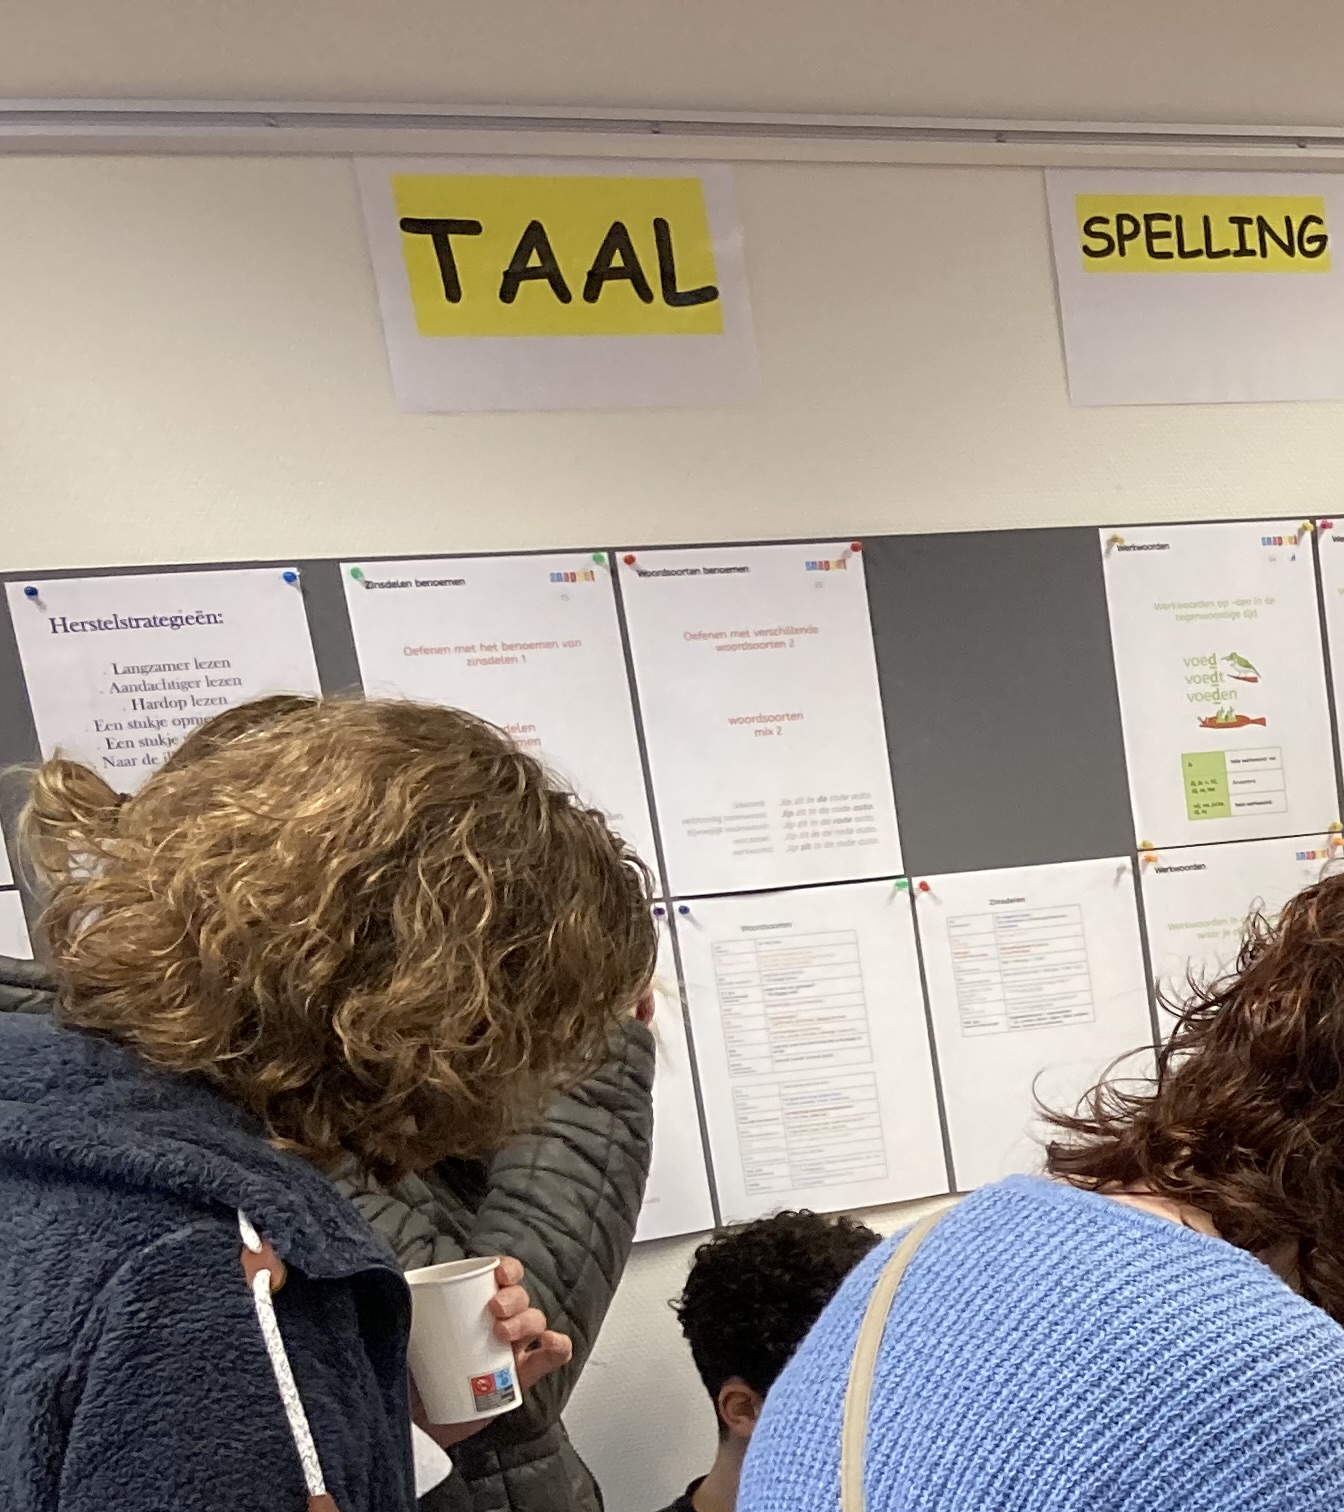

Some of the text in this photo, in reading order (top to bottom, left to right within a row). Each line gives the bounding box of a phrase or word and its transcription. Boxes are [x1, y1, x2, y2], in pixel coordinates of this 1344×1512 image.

[1082, 213, 1328, 258] SPELLING
[400, 217, 719, 307] TAAL
[637, 568, 700, 578] Woordsoorten
[365, 577, 466, 590] Zinsdelen benoemen
[49, 609, 224, 634] Herstelstrategieën:
[683, 630, 727, 640] Oefenen
[730, 629, 750, 639] met
[403, 645, 450, 656] Oefenen
[454, 645, 476, 654] met
[480, 642, 498, 652] het
[501, 639, 559, 651] benoemen
[112, 657, 231, 676] Langzamer lezen
[466, 655, 519, 667] zinsdelen
[1183, 652, 1217, 669] voed
[109, 675, 242, 695] Aandachtiger lezen
[1185, 670, 1224, 686] voedt
[131, 694, 228, 712] Hardop lezen
[1187, 688, 1237, 704] voeden
[94, 715, 168, 733] Een stukje
[728, 712, 804, 725] woordsoorten
[754, 726, 783, 737] mix 2
[106, 733, 177, 750] Een stukje
[103, 755, 137, 769] Naar
[142, 753, 159, 766] de
[1154, 863, 1206, 874] Werkwoorden
